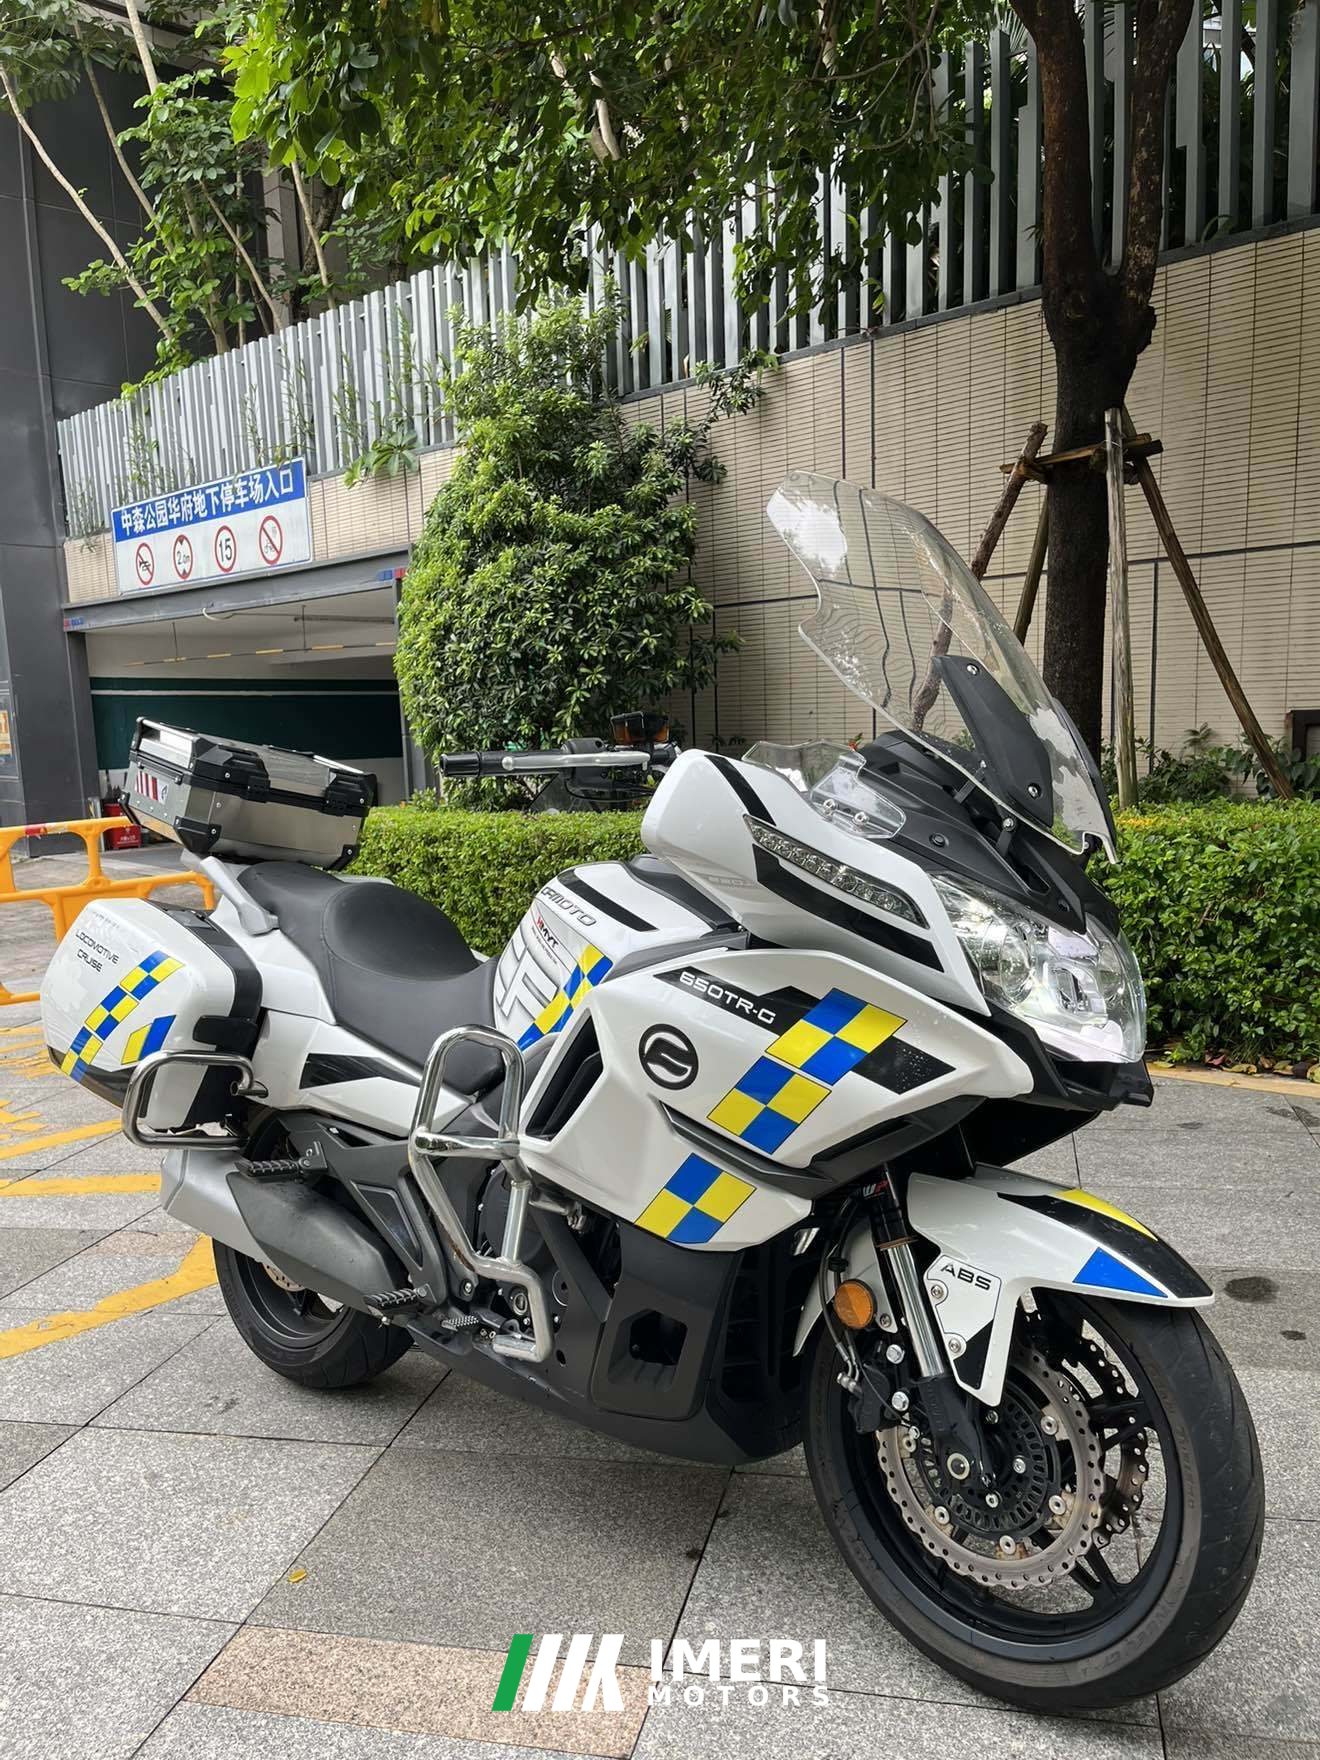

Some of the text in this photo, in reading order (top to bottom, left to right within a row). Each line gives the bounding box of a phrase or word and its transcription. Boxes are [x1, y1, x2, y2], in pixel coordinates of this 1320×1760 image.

[121, 469, 294, 536] 中森公园华府地下停车场入口
[219, 538, 233, 563] 15
[76, 929, 120, 965] LOCOMOTIVE
[680, 971, 776, 1025] 650TR-G
[941, 1263, 992, 1291] ABS
